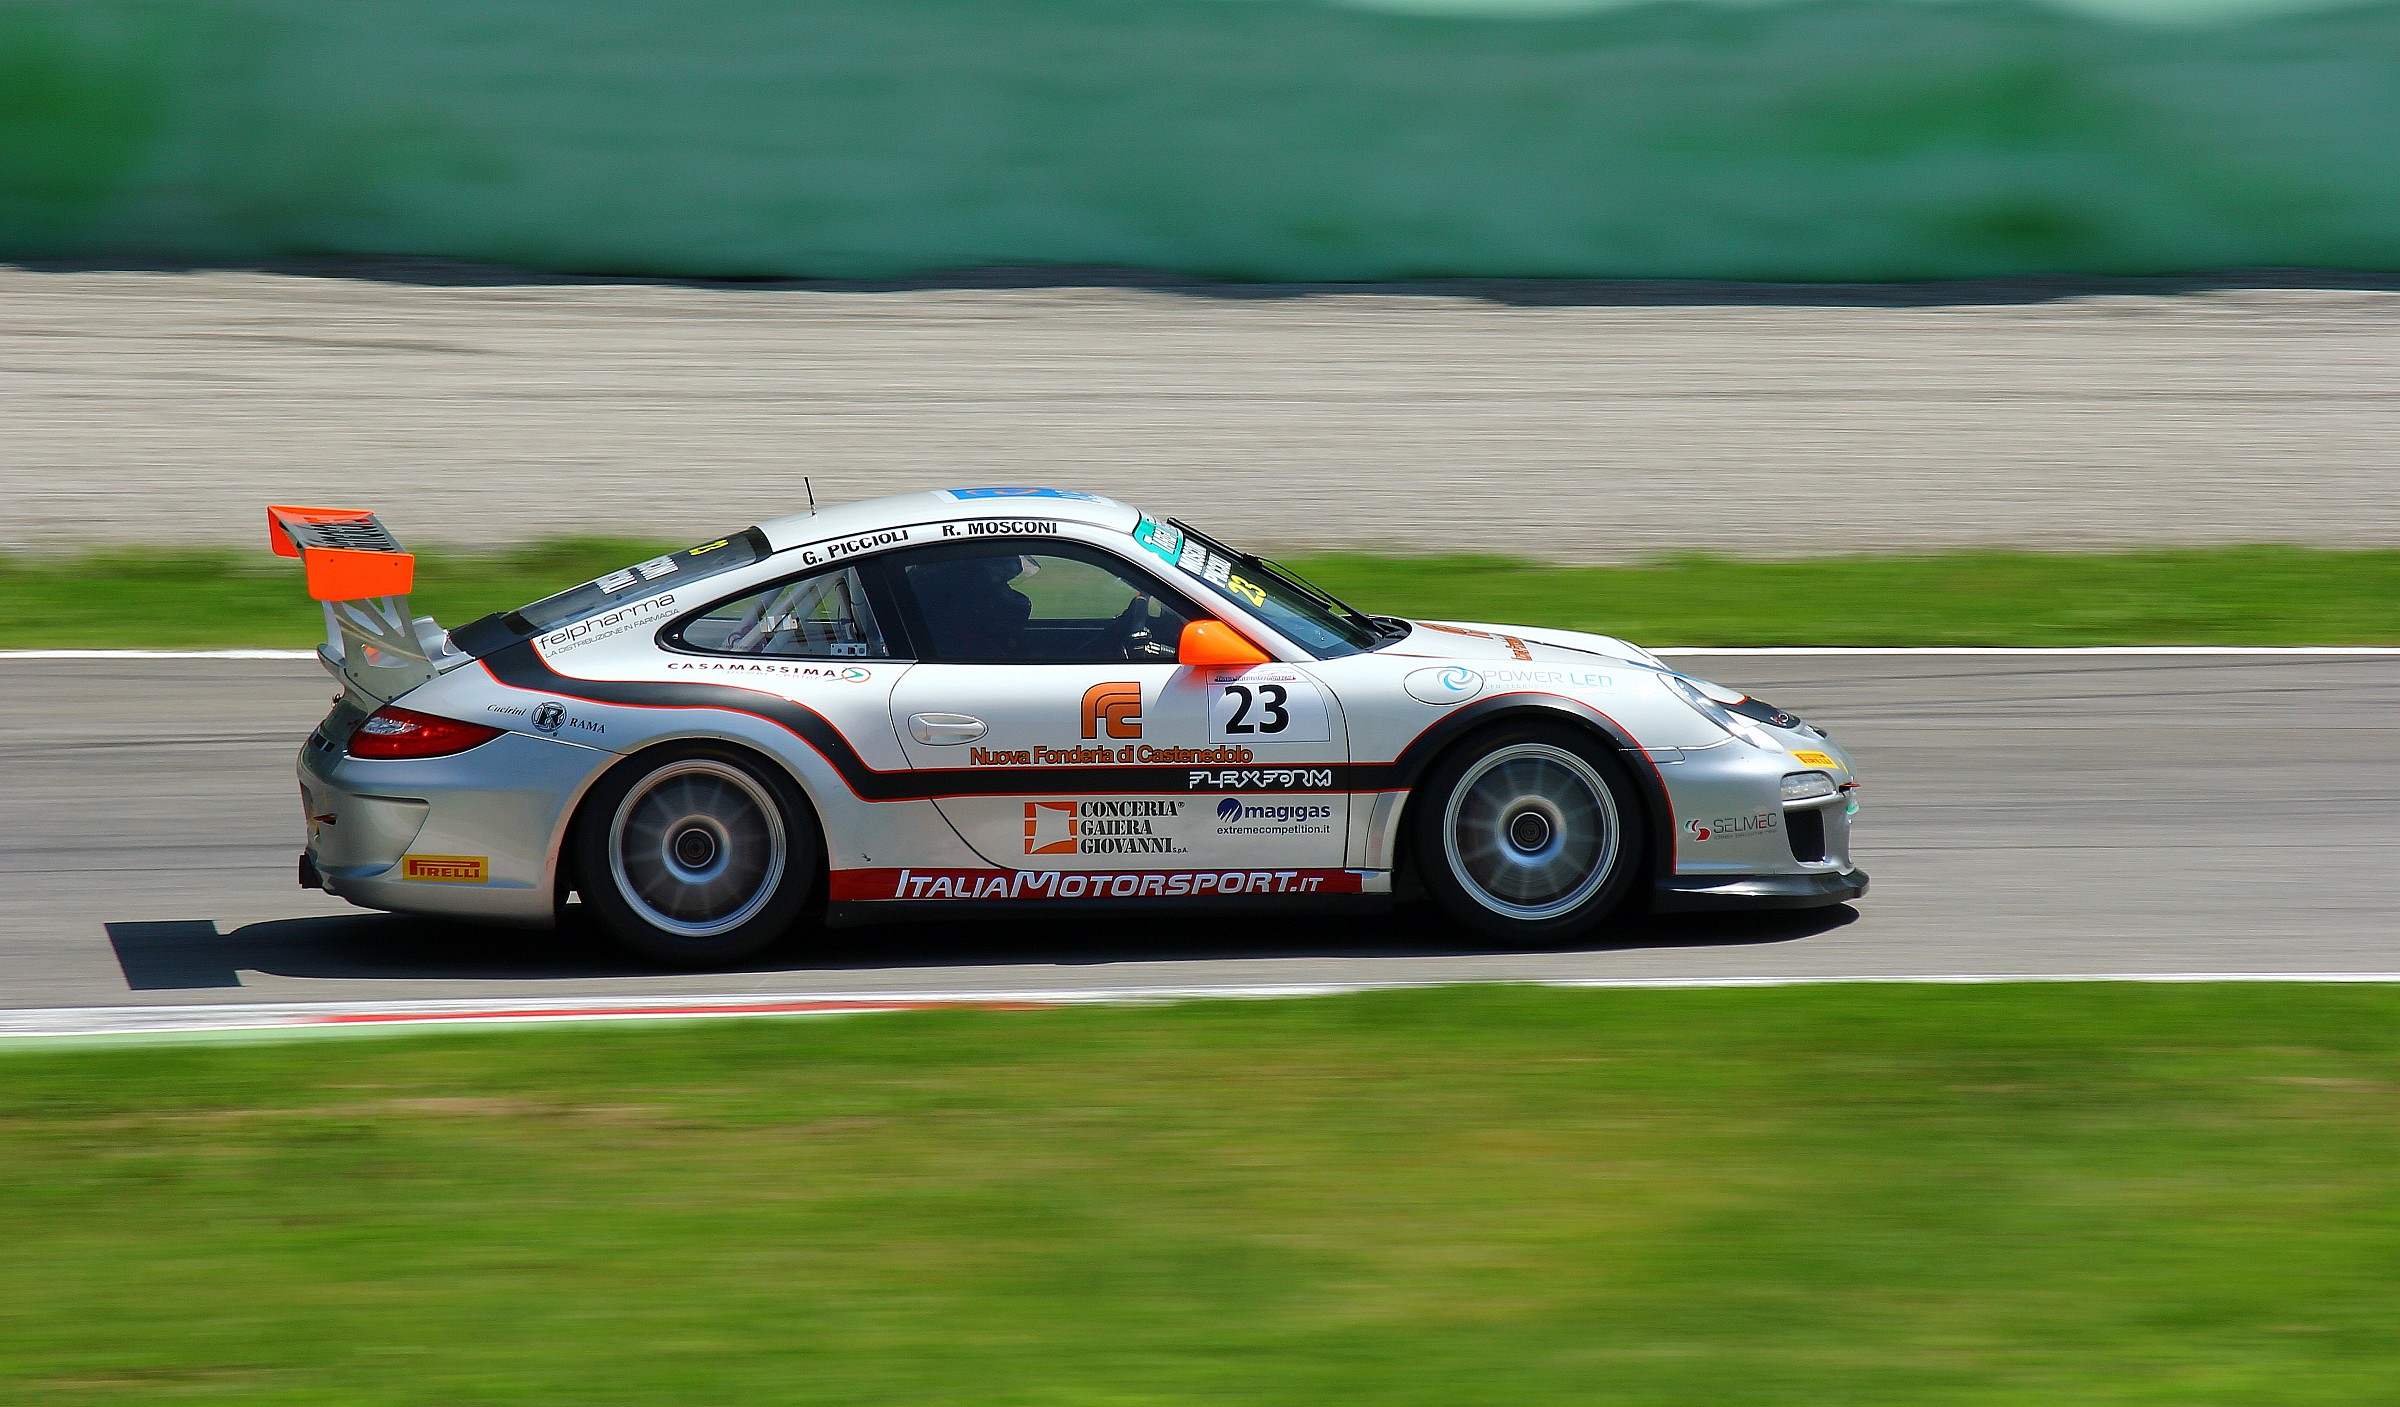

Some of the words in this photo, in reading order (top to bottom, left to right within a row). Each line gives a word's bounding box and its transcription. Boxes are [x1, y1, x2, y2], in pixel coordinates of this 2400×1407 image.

[942, 525, 961, 537] R.
[968, 521, 1058, 535] MOSCONI
[803, 551, 823, 566] G.
[828, 530, 909, 559] PICCIOLI
[1227, 574, 1267, 608] 23
[539, 593, 676, 649] felpharma
[545, 650, 558, 658] LA
[558, 628, 624, 654] DISTRIBUZIONE
[624, 623, 634, 632] IN
[633, 608, 680, 628] FARMACIA
[667, 663, 836, 677] CASAMASSIMA
[1483, 670, 1564, 684] POWER
[1570, 673, 1613, 688] LED
[487, 704, 527, 716] Cucirini
[569, 718, 606, 734] RAMA
[1225, 684, 1290, 734] 23
[970, 747, 1031, 765] Nuova
[1034, 745, 1116, 765] Fonderia
[1118, 745, 1135, 764] di
[1137, 745, 1253, 764] Castenedolo
[1189, 769, 1332, 789] FLEXFORM
[1245, 805, 1331, 822] magigas
[1713, 812, 1777, 834] SELMEC
[1081, 819, 1153, 836] GAIERA
[1217, 825, 1331, 836] extremecompetition.it
[1081, 838, 1173, 854] GIOVANNI
[410, 859, 481, 878] PIRELLI
